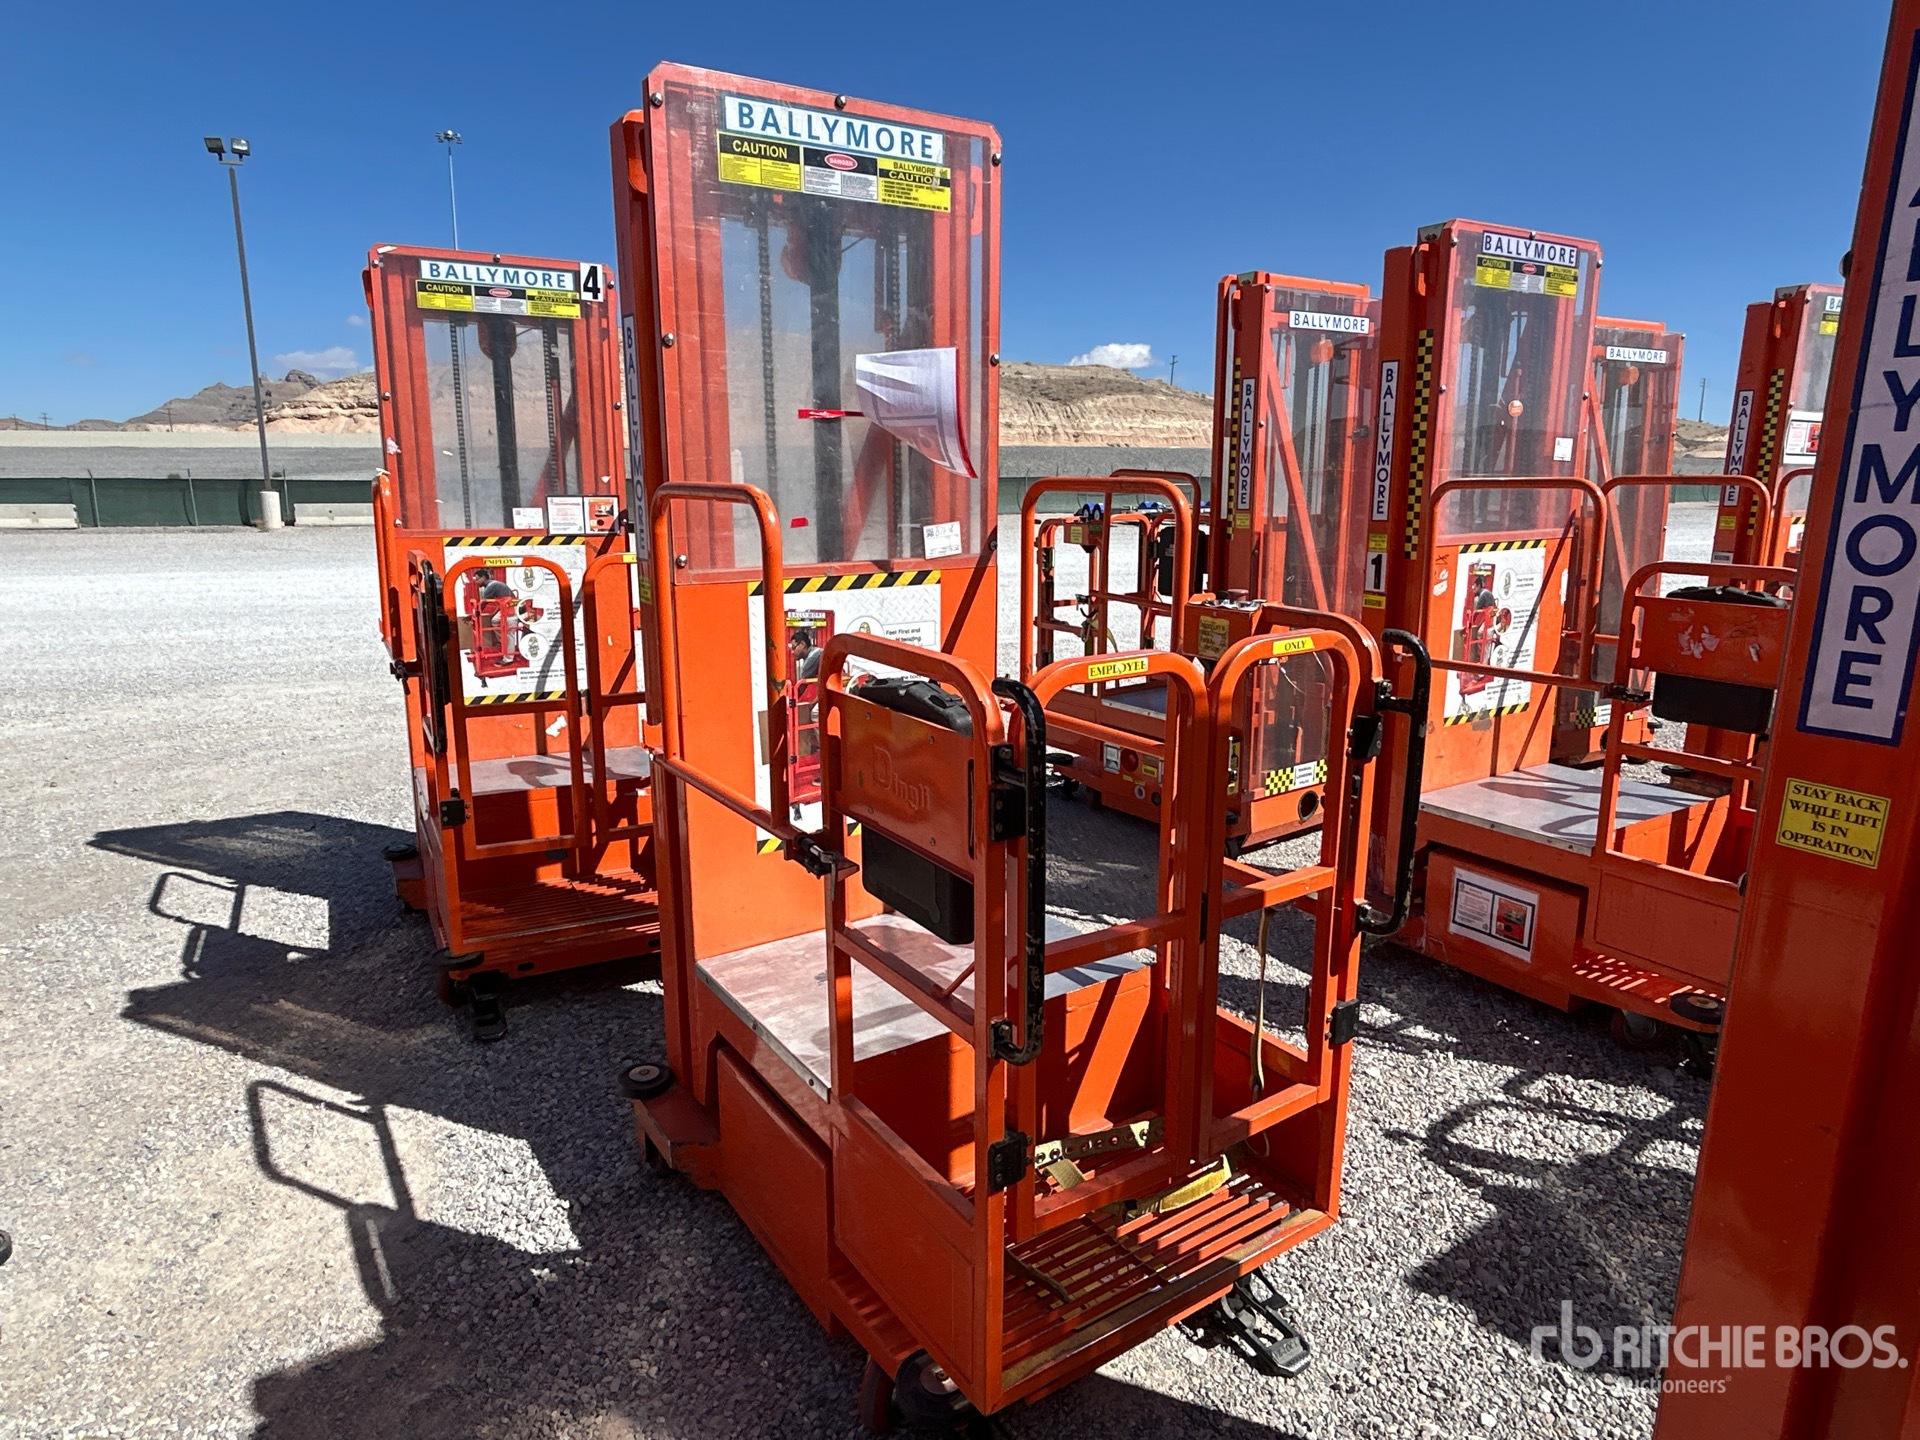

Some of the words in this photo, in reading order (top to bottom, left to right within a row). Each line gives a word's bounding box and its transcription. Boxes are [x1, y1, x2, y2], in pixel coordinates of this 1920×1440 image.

[737, 102, 933, 159] BALLYMORE
[732, 139, 788, 159] CAUTION
[888, 170, 941, 186] CAUTION
[893, 161, 936, 174] BALLYMORE
[1484, 235, 1576, 264] BALLYMORE
[429, 263, 567, 288] BALLYMORE
[1481, 258, 1507, 269] CAUTION
[425, 283, 464, 294] CAUTION
[583, 265, 601, 300] 4
[1294, 313, 1366, 332] BALLYMORE
[1609, 348, 1664, 362] BALLYMORE
[626, 326, 647, 550] BALLYMORE
[1240, 383, 1252, 505] BALLYMORE
[1376, 368, 1394, 515] BALLYMORE
[1371, 553, 1383, 590] 1
[1284, 640, 1307, 651] ONLY
[1792, 784, 1832, 800] STAY
[1834, 792, 1882, 812] BACK
[1788, 799, 1841, 820] WHILE
[1844, 811, 1881, 828] LIFT
[1810, 820, 1826, 833] IS
[1829, 824, 1850, 838] IN
[1781, 829, 1875, 861] OPERATION
